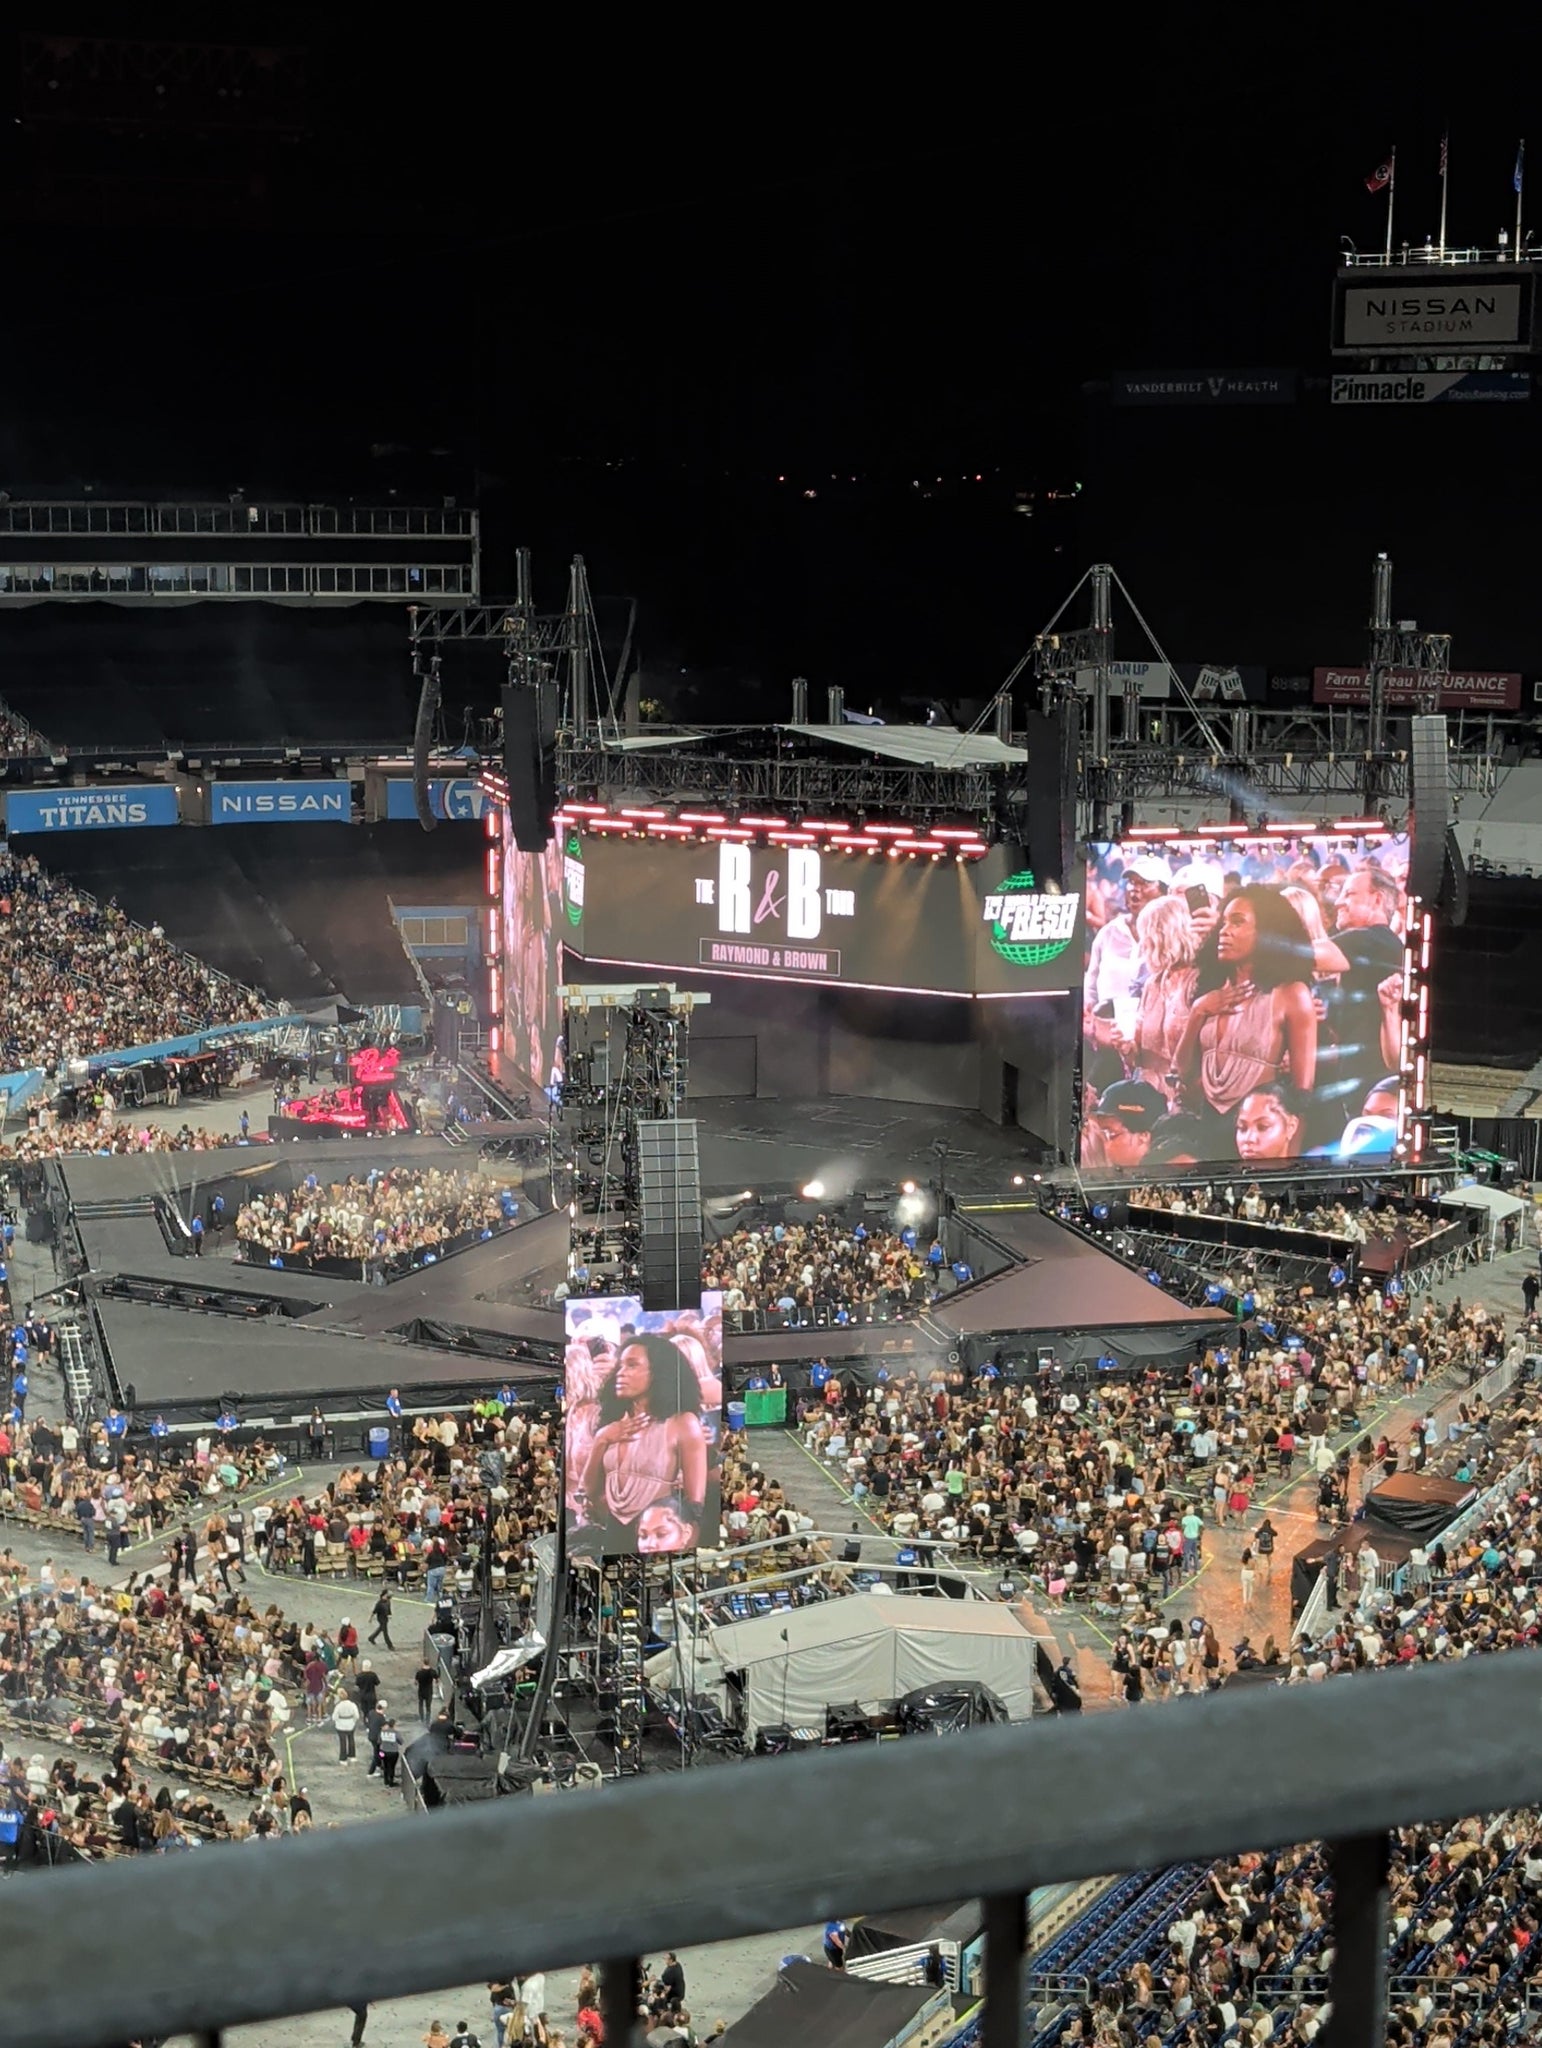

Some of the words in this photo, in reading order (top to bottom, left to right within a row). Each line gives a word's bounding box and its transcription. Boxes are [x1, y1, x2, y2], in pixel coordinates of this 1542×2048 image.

[1366, 297, 1496, 317] NISSAN
[1386, 320, 1473, 334] STADIUM
[1125, 380, 1204, 394] VANDERBILT
[1227, 380, 1279, 393] HEALTH
[1333, 377, 1425, 401] Pinnacle
[1325, 672, 1361, 686] Farm
[1364, 674, 1413, 688] Breau
[57, 794, 127, 805] TENNESSEE
[221, 794, 343, 813] NISSAN
[39, 804, 148, 828] TITANS
[1000, 904, 1078, 941] FRESH
[711, 943, 770, 966] RAYMOND
[772, 950, 781, 967] &
[783, 950, 828, 971] BROWN
